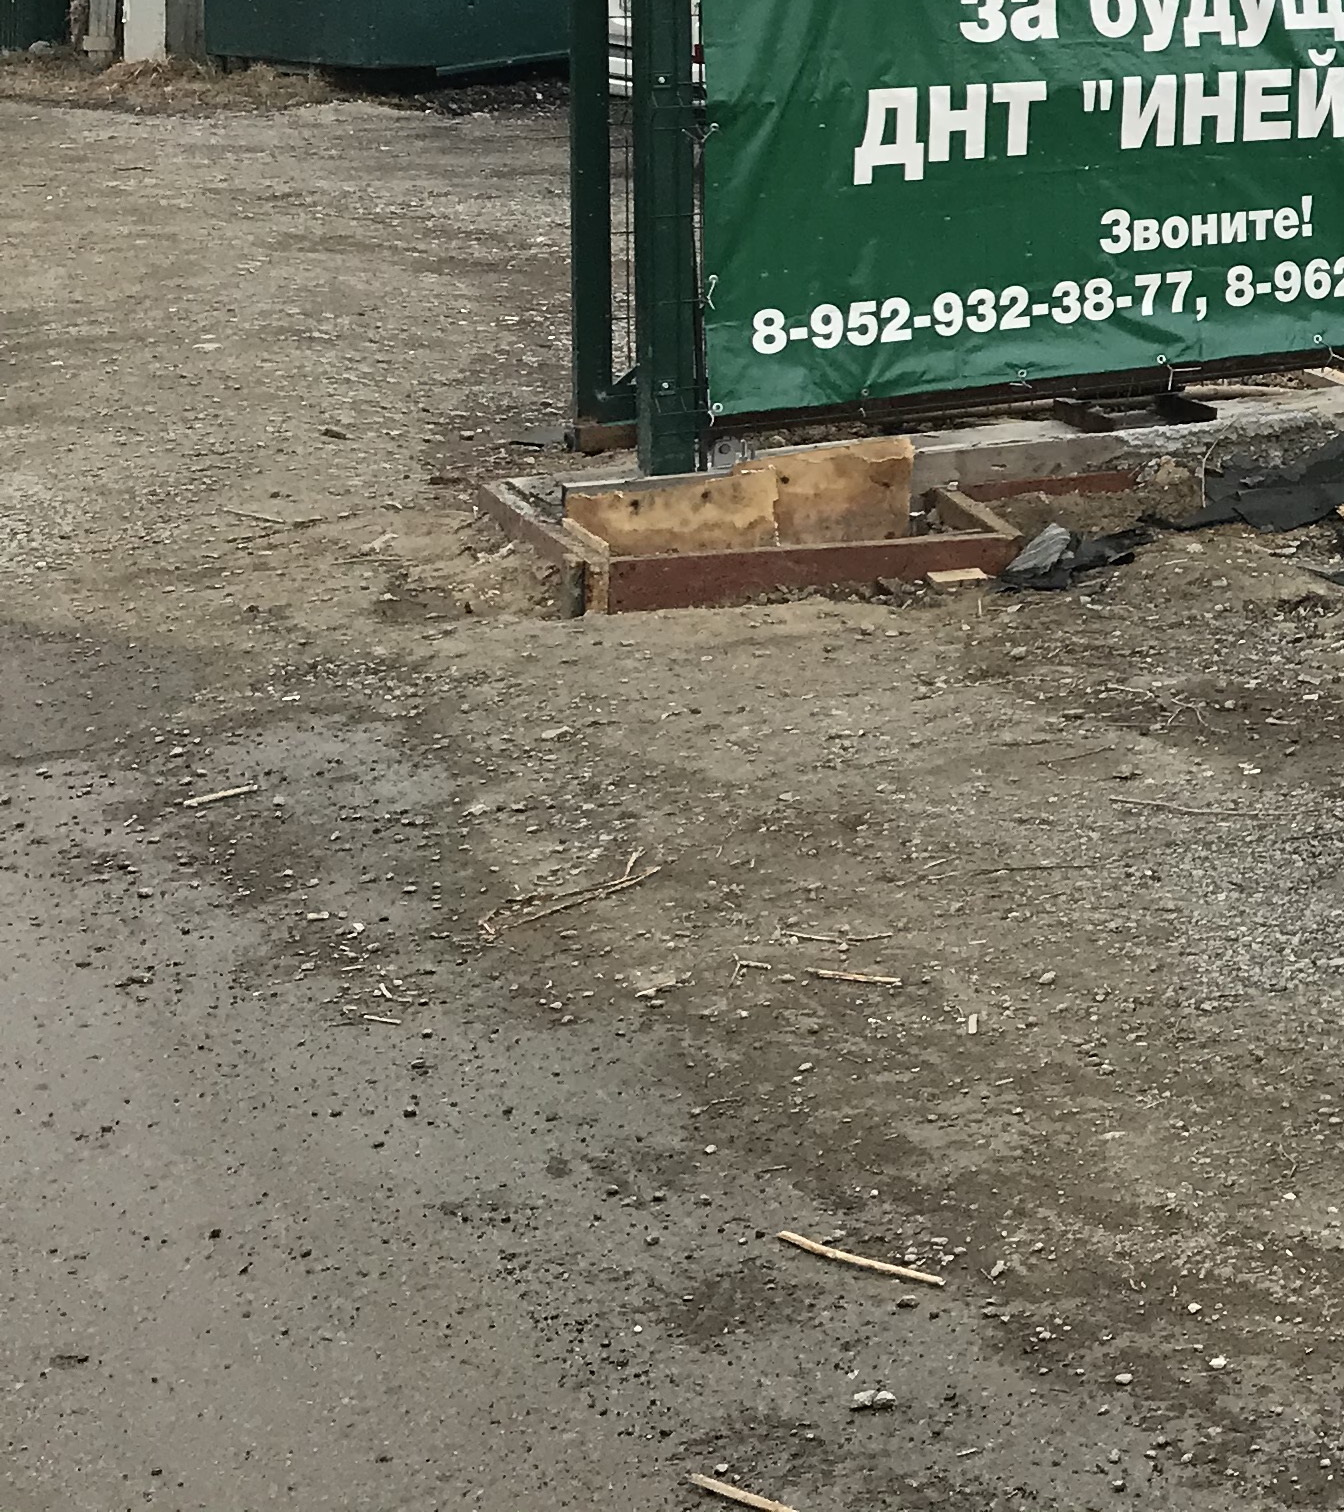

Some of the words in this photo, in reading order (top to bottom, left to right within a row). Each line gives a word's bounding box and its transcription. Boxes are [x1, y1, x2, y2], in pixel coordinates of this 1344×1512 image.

[854, 81, 1046, 185] ДНТ
[1100, 196, 1312, 253] Звоните!
[753, 271, 1206, 354] 8-952-932-38-77,
